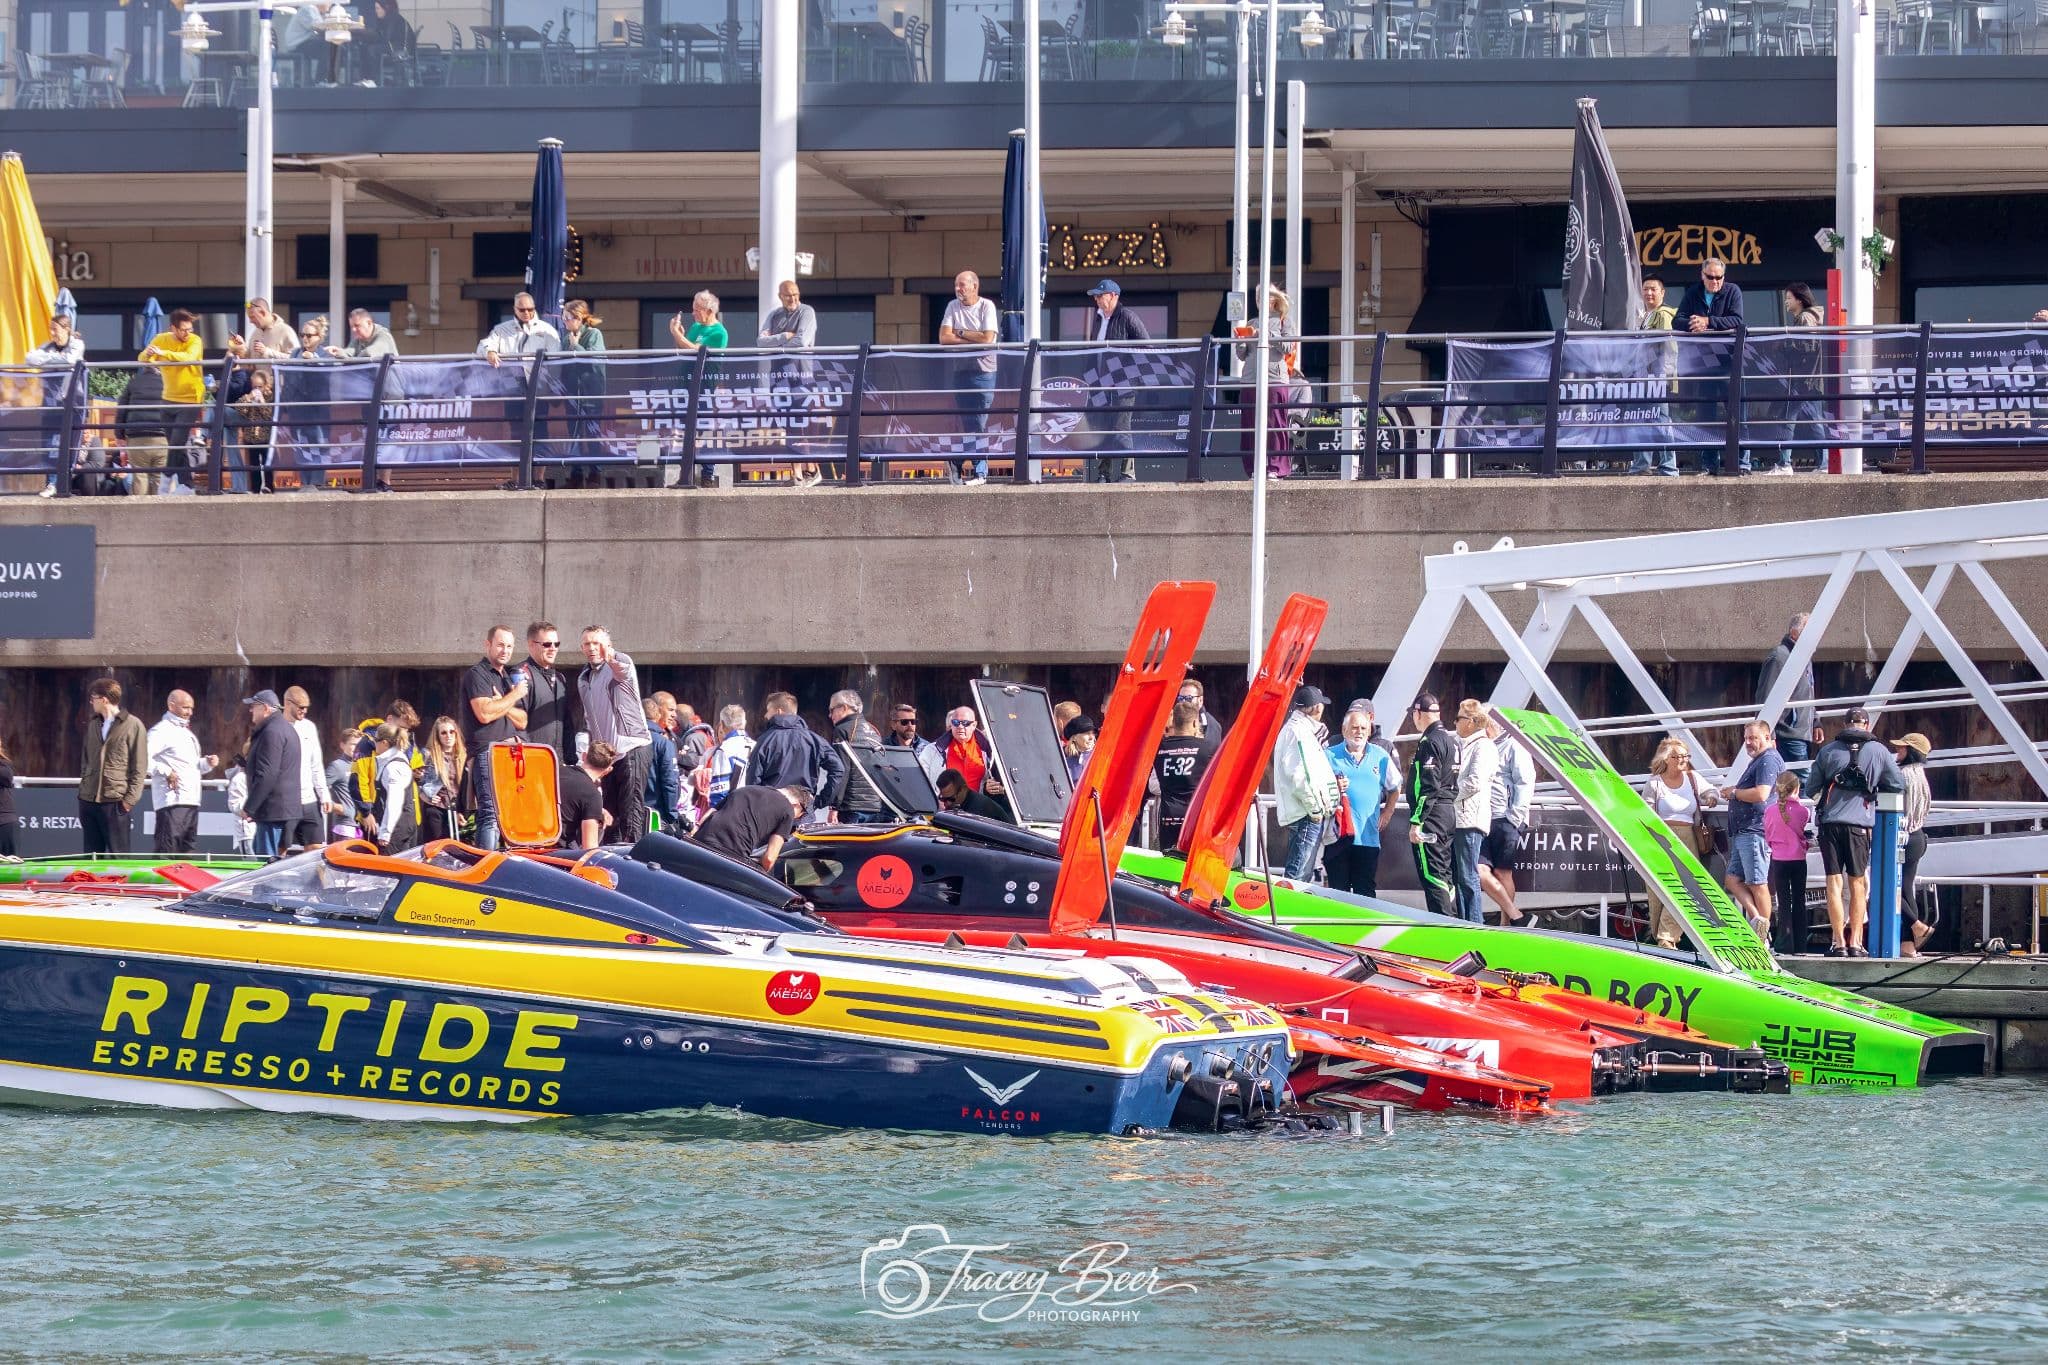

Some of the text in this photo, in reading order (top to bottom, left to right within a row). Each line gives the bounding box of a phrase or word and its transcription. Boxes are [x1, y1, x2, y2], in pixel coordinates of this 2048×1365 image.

[636, 257, 741, 275] INDIVIDUALLY
[0, 591, 38, 599] OPPING
[1163, 757, 1196, 777] E-32
[29, 816, 39, 829] &
[1560, 862, 1600, 872] OUTLET
[862, 885, 905, 895] MEDIA
[410, 911, 475, 926] Dean Stoneman
[769, 990, 813, 1001] MEDIA
[101, 975, 579, 1072] RIPTIDE
[1760, 1023, 1857, 1052] JJB
[1760, 1045, 1854, 1064] SIGNS
[92, 1040, 562, 1106] ESPRESSO + RECORDS
[961, 1107, 1041, 1122] FALCON
[980, 1121, 1021, 1130] TENDERS
